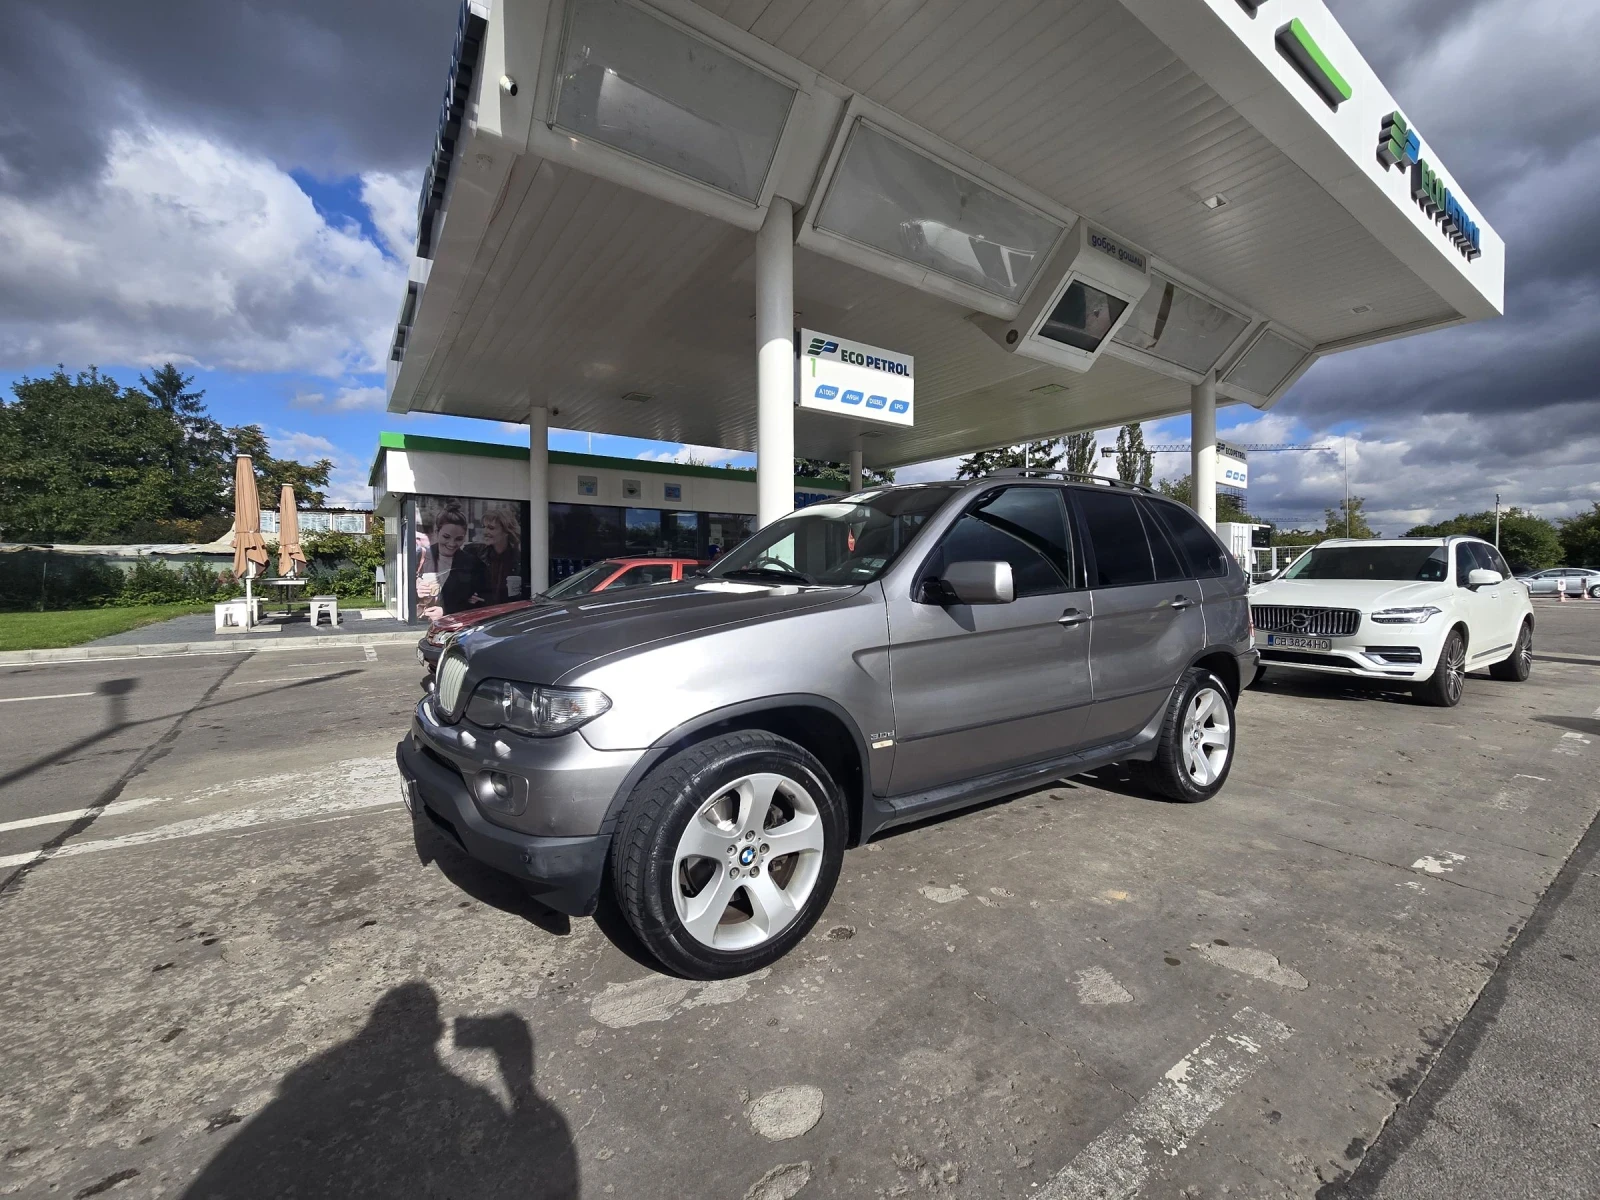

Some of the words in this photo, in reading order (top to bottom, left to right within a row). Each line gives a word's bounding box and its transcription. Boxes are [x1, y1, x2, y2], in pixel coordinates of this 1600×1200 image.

[1091, 234, 1116, 254] добре
[1118, 248, 1143, 267] дошли
[841, 349, 865, 366] ECO
[866, 355, 910, 377] PETROL
[1288, 637, 1313, 648] 3824
